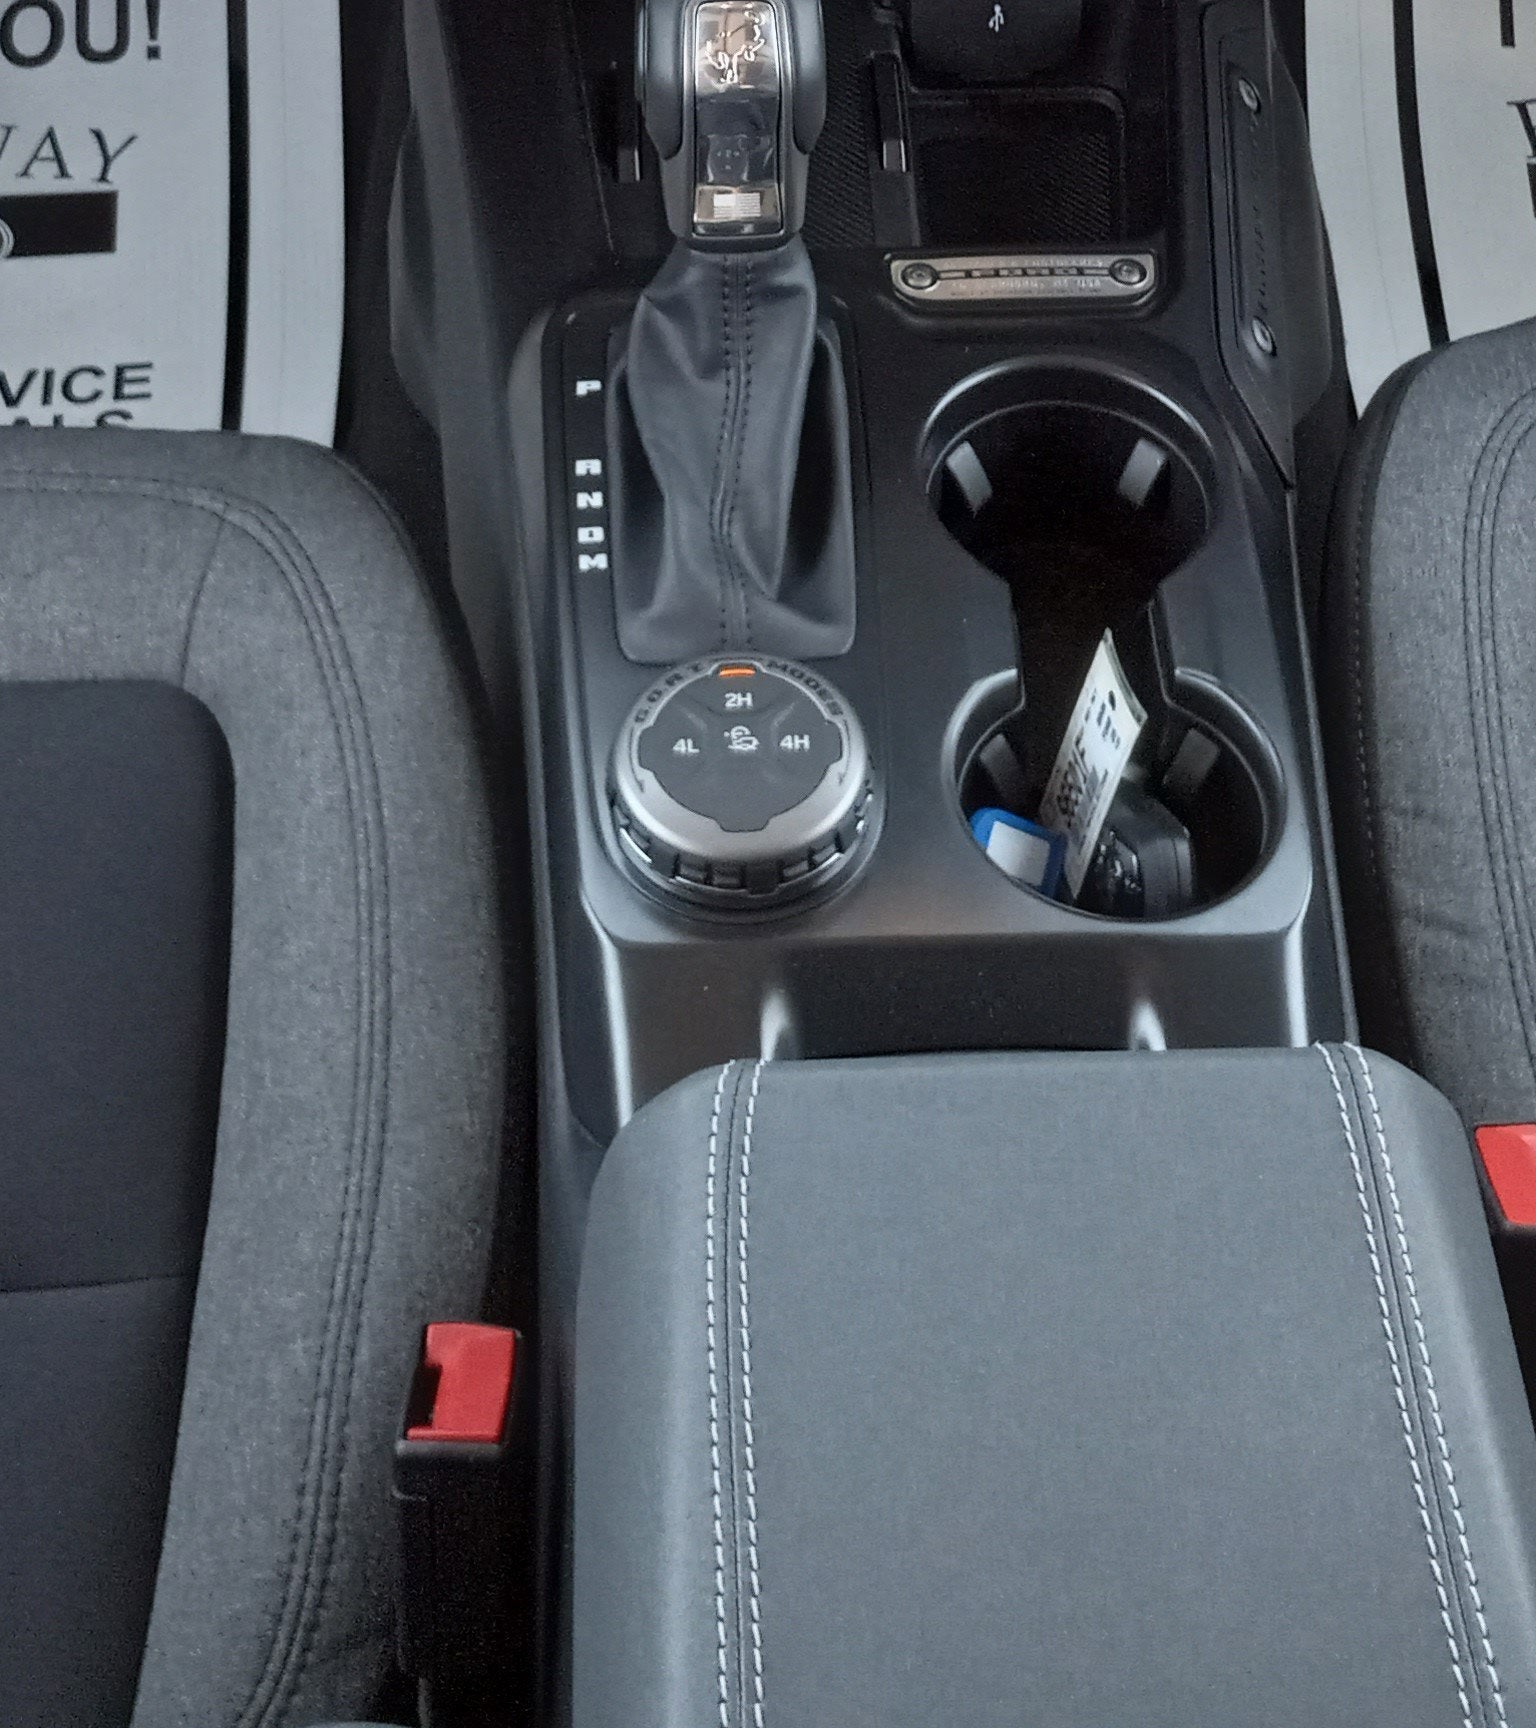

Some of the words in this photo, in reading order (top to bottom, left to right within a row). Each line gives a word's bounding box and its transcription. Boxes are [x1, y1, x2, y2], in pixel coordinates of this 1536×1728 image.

[575, 379, 602, 397] P
[575, 459, 602, 476] R
[576, 491, 603, 509] N
[577, 526, 604, 544] D
[578, 553, 608, 572] M
[725, 692, 753, 709] 2H
[673, 738, 700, 754] 4L
[779, 734, 810, 751] 4H
